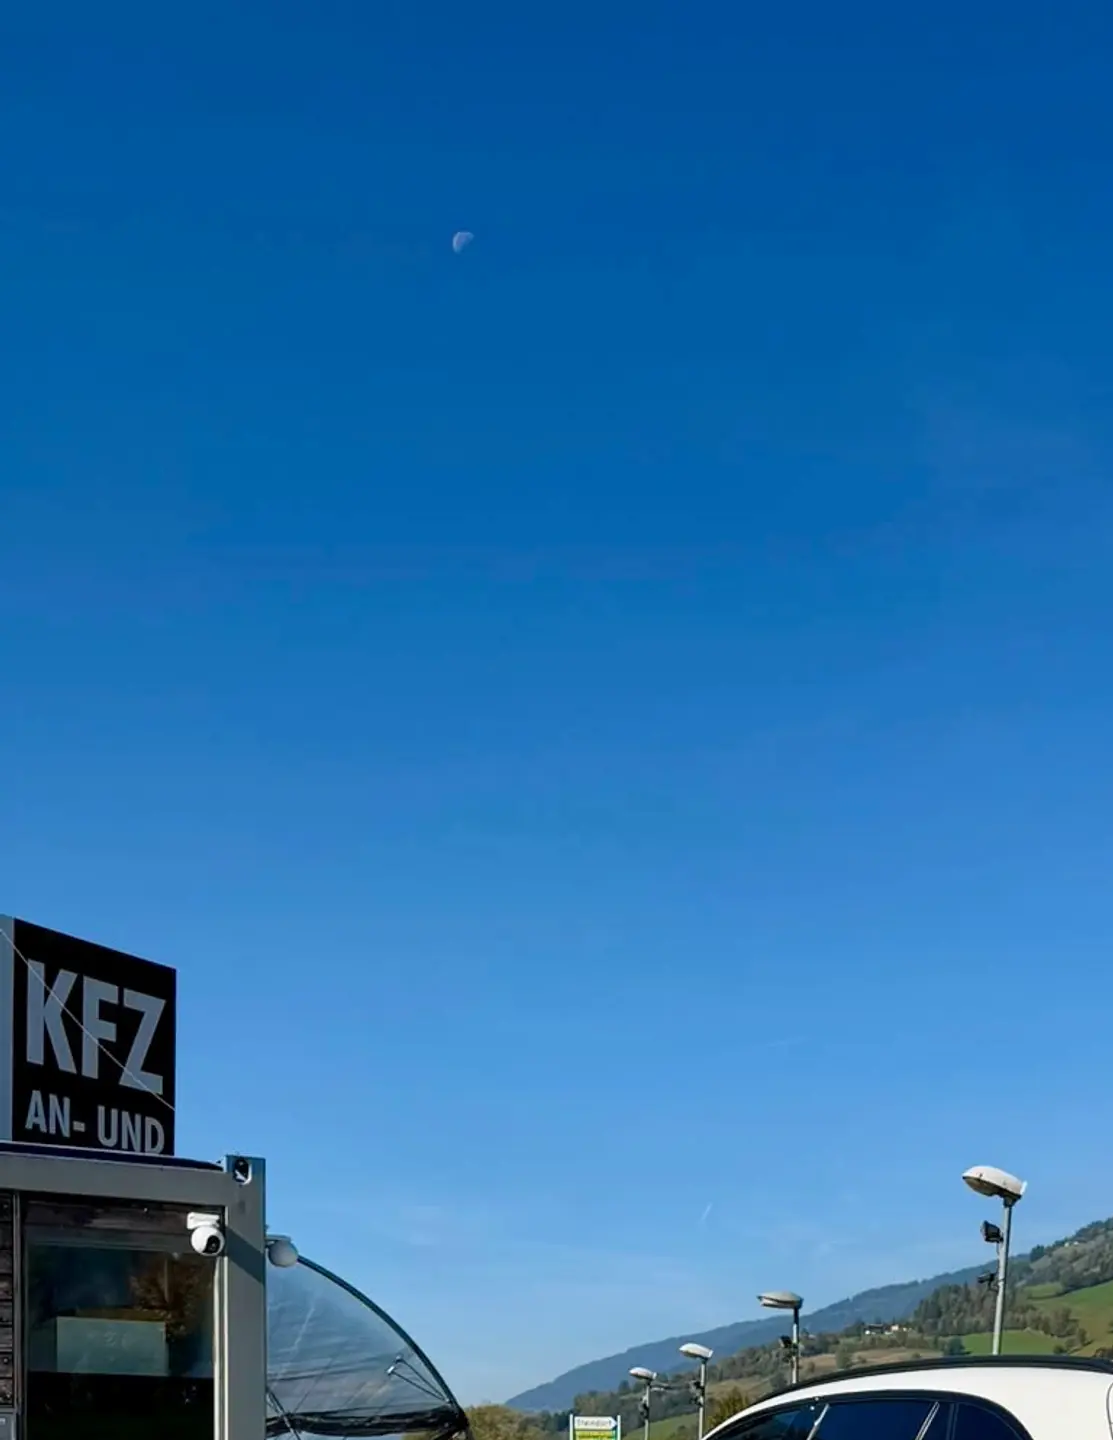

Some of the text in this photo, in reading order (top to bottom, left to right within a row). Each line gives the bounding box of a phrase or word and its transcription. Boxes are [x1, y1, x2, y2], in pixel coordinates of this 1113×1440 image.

[27, 957, 167, 1096] KFZ
[24, 1089, 166, 1155] AN- UND
